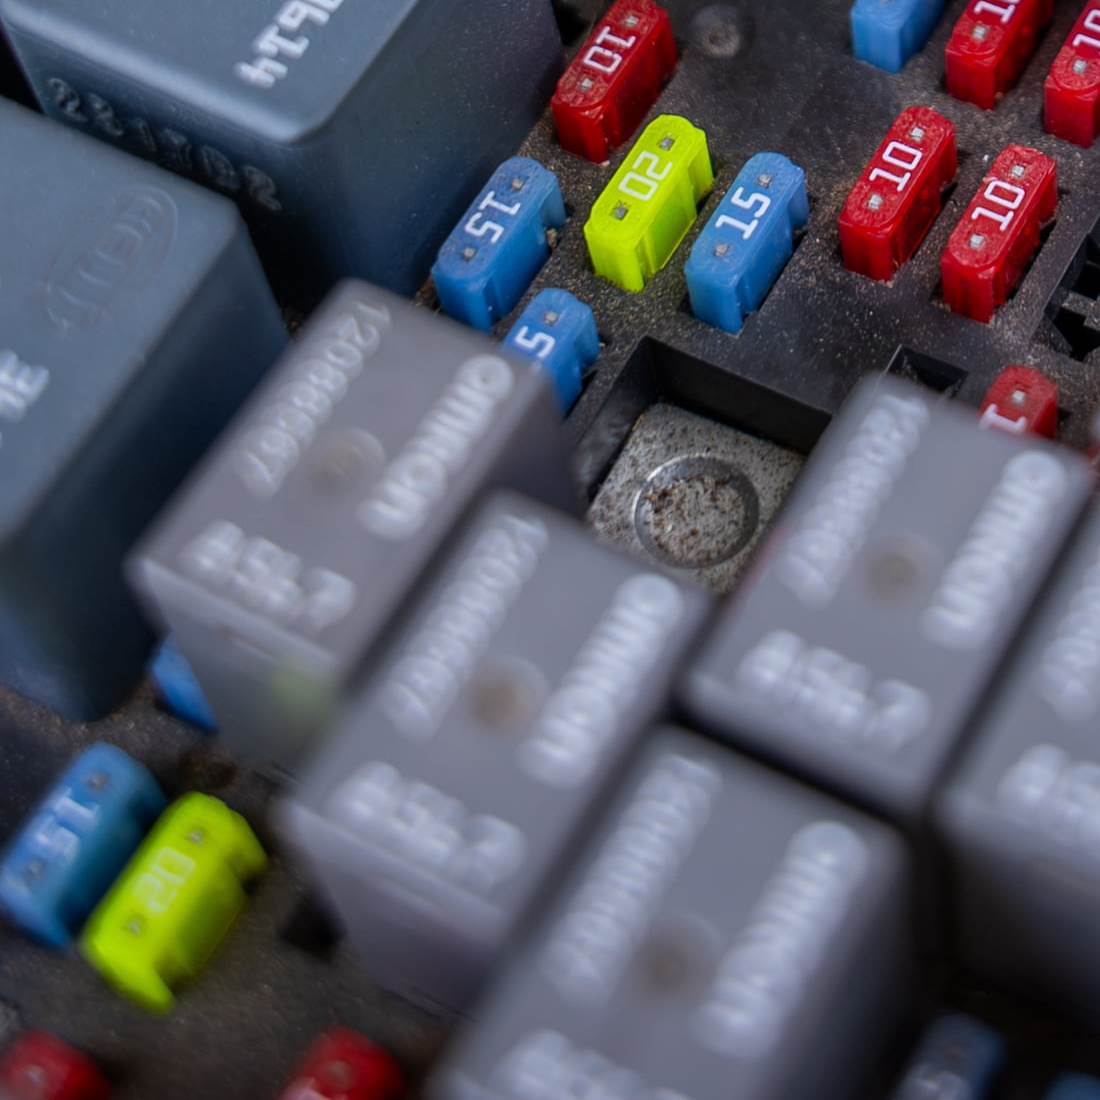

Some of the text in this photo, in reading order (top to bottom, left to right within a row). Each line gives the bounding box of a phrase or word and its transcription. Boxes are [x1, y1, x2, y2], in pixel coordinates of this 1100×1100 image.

[584, 27, 636, 75] 10
[619, 151, 672, 202] 20
[870, 141, 922, 191] 10
[465, 191, 520, 241] 15
[715, 187, 770, 239] 15
[971, 180, 1025, 231] 10
[30, 788, 101, 868] 15
[132, 846, 196, 918] 20
